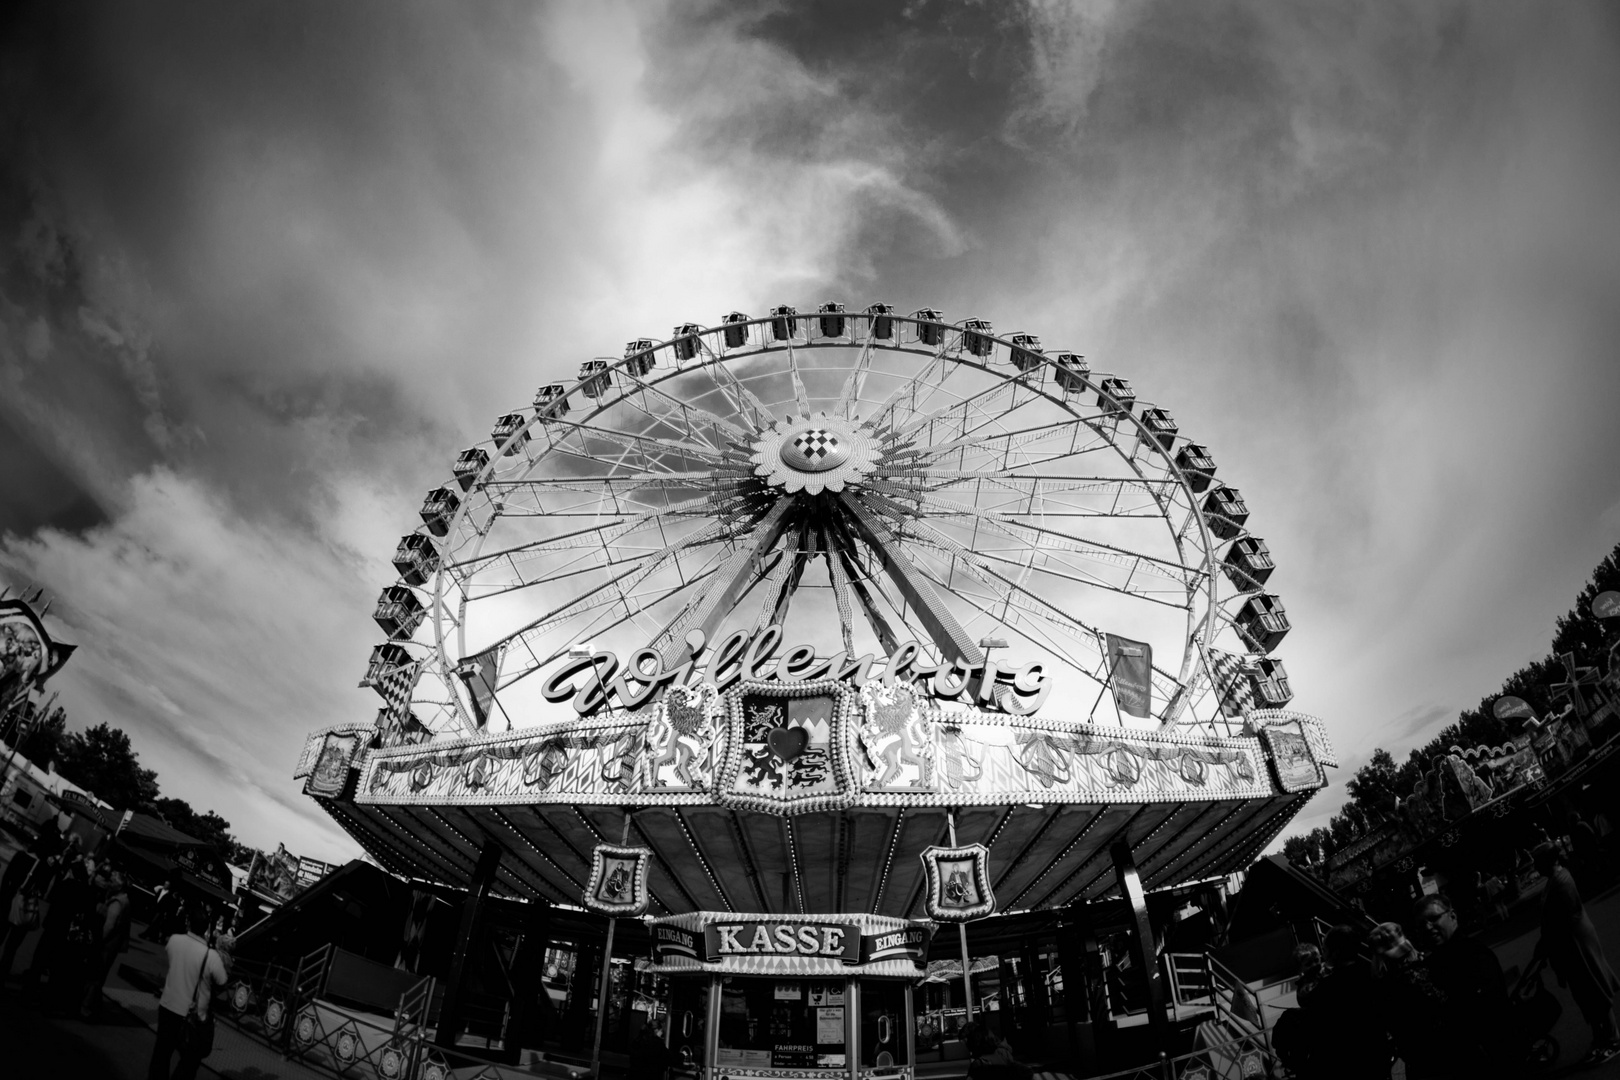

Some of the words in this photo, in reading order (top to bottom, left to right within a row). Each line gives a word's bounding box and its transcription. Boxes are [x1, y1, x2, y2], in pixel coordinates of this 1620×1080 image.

[541, 624, 1054, 717] Willenborg
[657, 927, 694, 949] EINGANG
[716, 925, 846, 956] KASSE
[874, 930, 923, 951] EINGANG
[774, 1044, 814, 1052] FAHRPREIS
